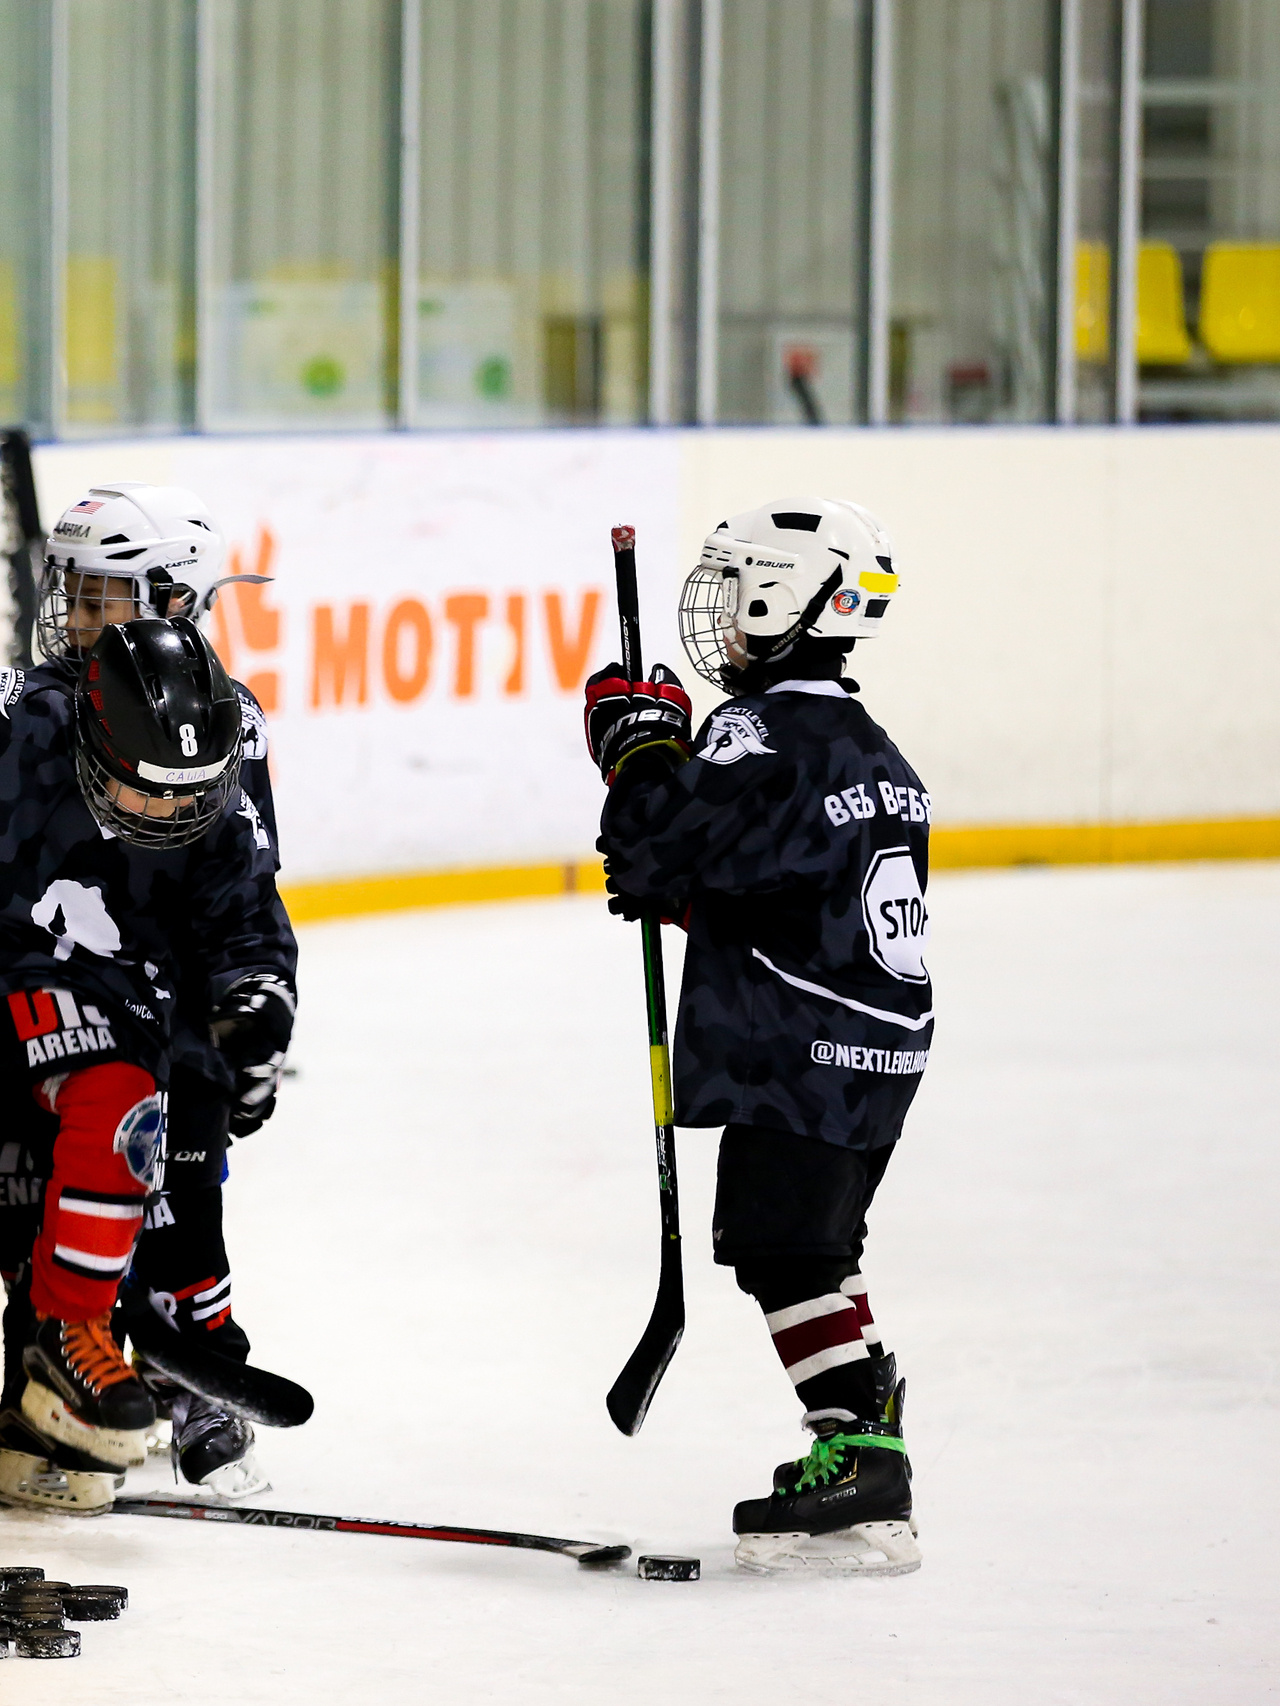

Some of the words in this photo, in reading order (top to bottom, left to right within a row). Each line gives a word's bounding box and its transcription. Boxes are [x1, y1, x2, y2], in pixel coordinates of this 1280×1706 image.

[165, 558, 198, 569] EASTON
[179, 723, 198, 757] 8
[26, 1026, 117, 1068] ARENA
[236, 1511, 337, 1531] VAPOR
